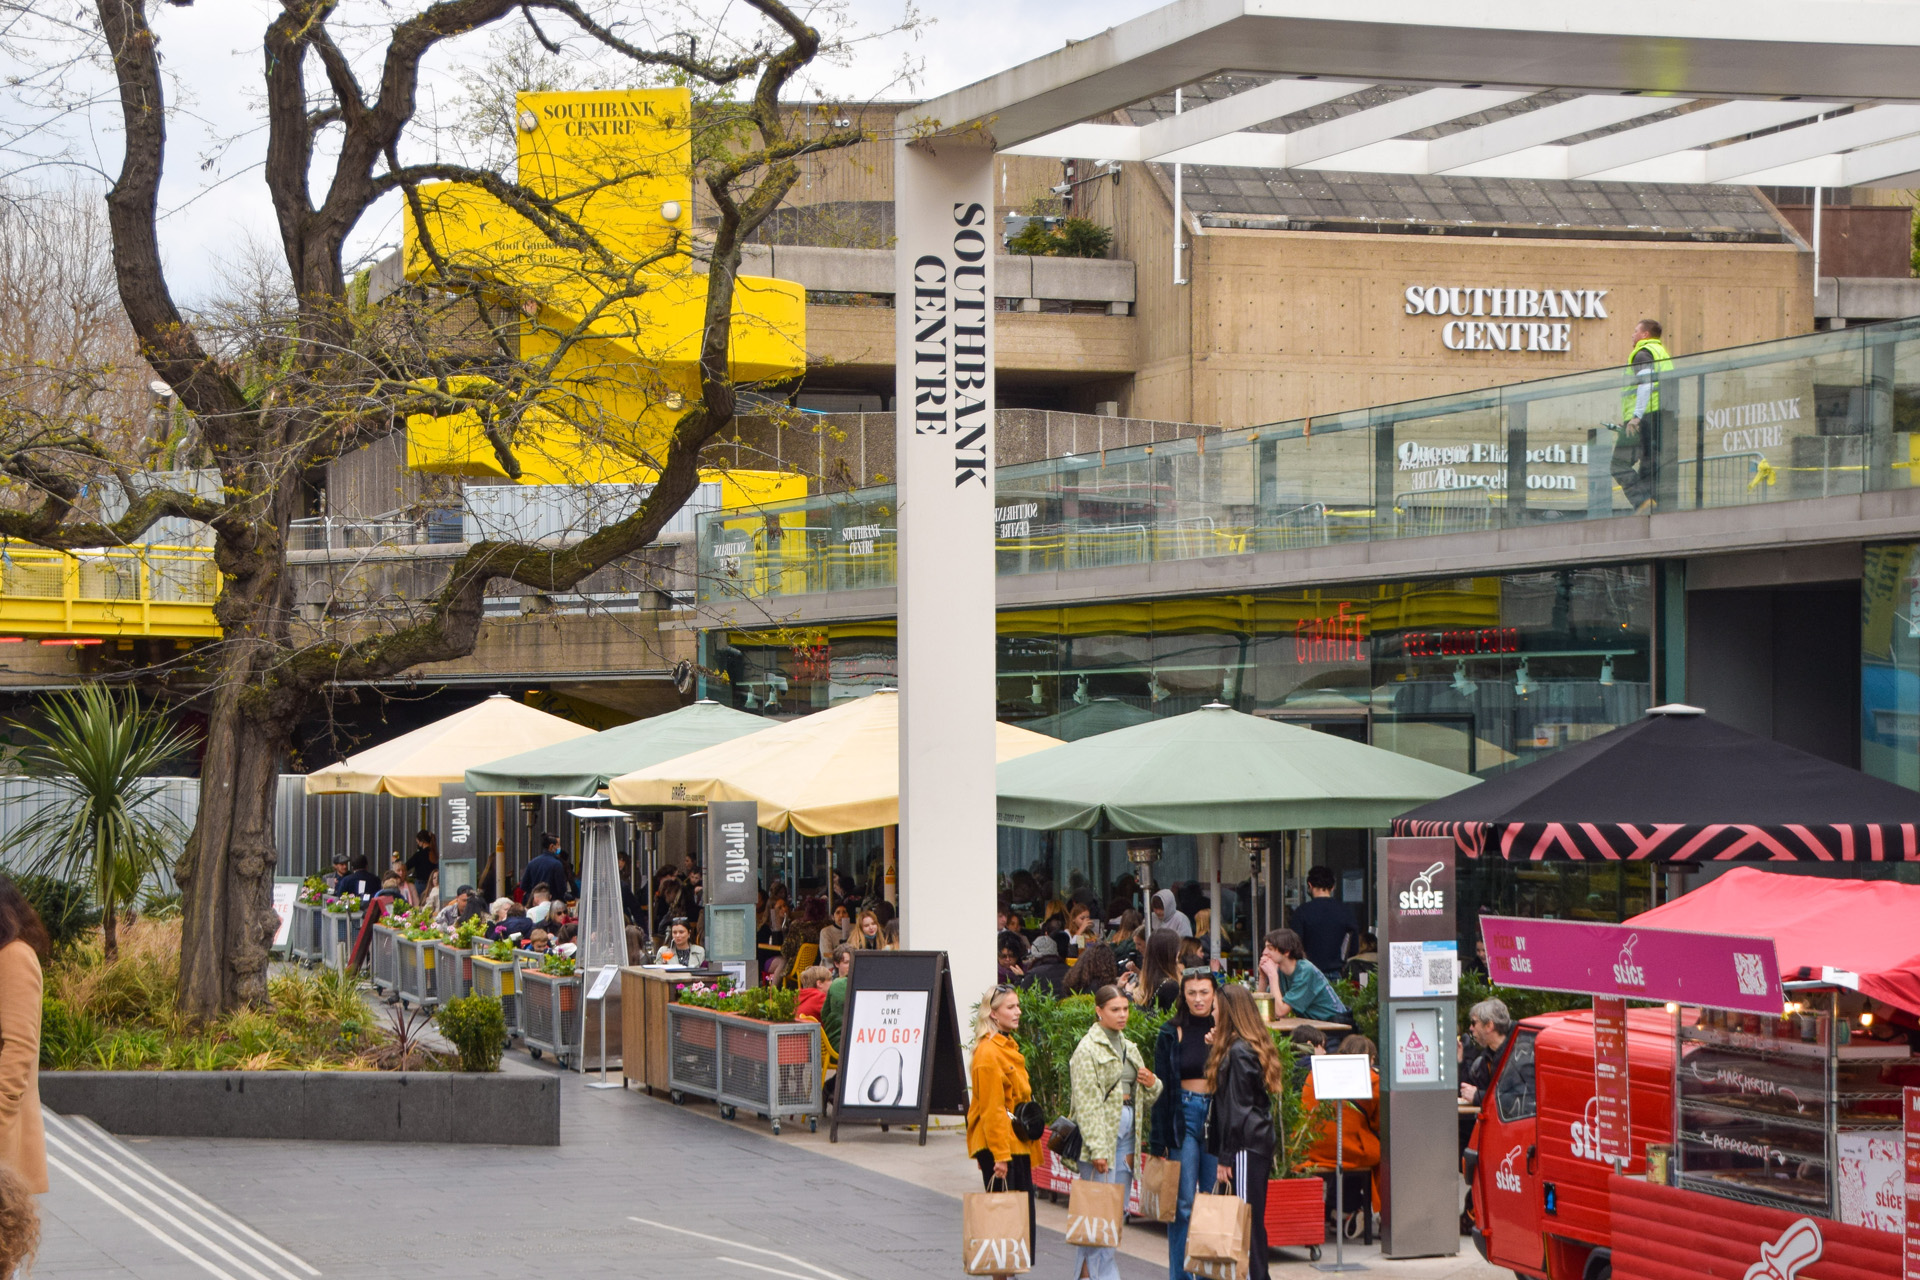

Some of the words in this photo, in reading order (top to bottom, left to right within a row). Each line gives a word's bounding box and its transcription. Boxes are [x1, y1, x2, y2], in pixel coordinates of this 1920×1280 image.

[544, 101, 656, 120] SOUTHBANK
[565, 120, 636, 137] CENTRE
[494, 240, 519, 251] Roof
[540, 254, 559, 264] Bar
[1405, 286, 1609, 319] SOUTHBANK
[914, 255, 947, 435] CENTRE
[953, 203, 987, 489] SOUTHBANK
[1442, 321, 1571, 352] CENTRE
[1705, 398, 1801, 431] SOUTHBANK
[1722, 425, 1783, 452] CENTRE
[1526, 474, 1576, 490] oom
[842, 524, 881, 541] SOUTHBANK
[849, 540, 875, 555] CENTRE
[448, 797, 470, 844] giraffe
[721, 821, 750, 883] giraffe
[1515, 936, 1526, 951] BY
[1495, 957, 1509, 971] THE
[856, 1028, 886, 1044] AVO
[891, 1028, 921, 1044] GO?
[1402, 1067, 1429, 1075] NUMBER
[1405, 1060, 1426, 1068] MAGIC
[1717, 1069, 1776, 1096] MARGHERITA
[1713, 1134, 1769, 1161] PEPPERONI
[1065, 1214, 1119, 1247] ZARA
[970, 1238, 1031, 1270] ZARA
